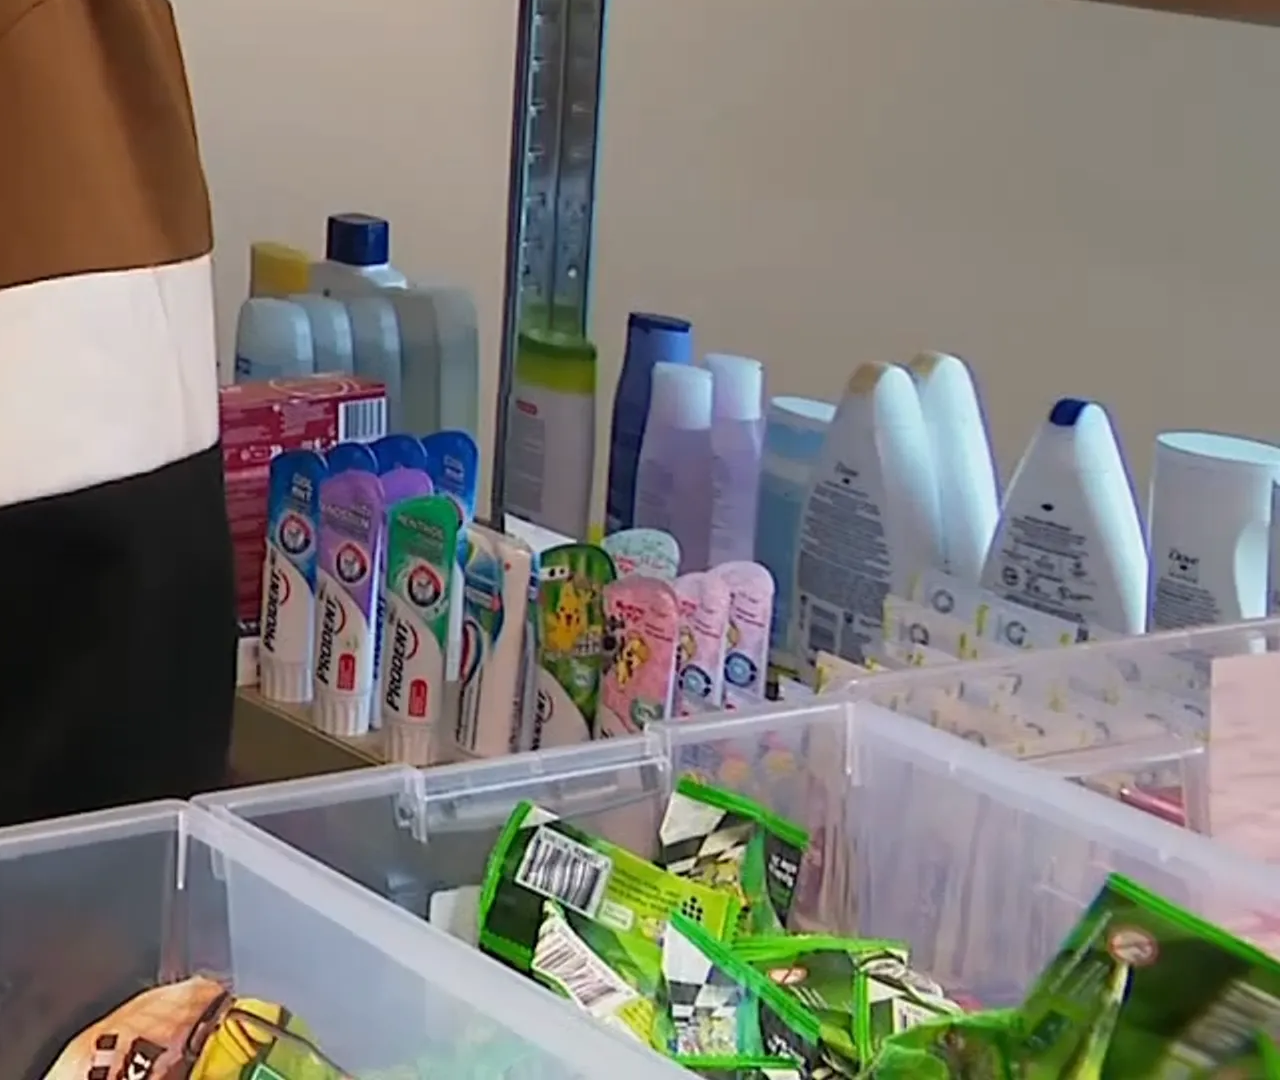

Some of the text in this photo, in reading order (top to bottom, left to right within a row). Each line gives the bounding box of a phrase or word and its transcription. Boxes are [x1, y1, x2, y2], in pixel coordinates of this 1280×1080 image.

[263, 569, 282, 653] PRODENT
[316, 593, 339, 686] PRODENT
[385, 618, 410, 713] PRODENT
